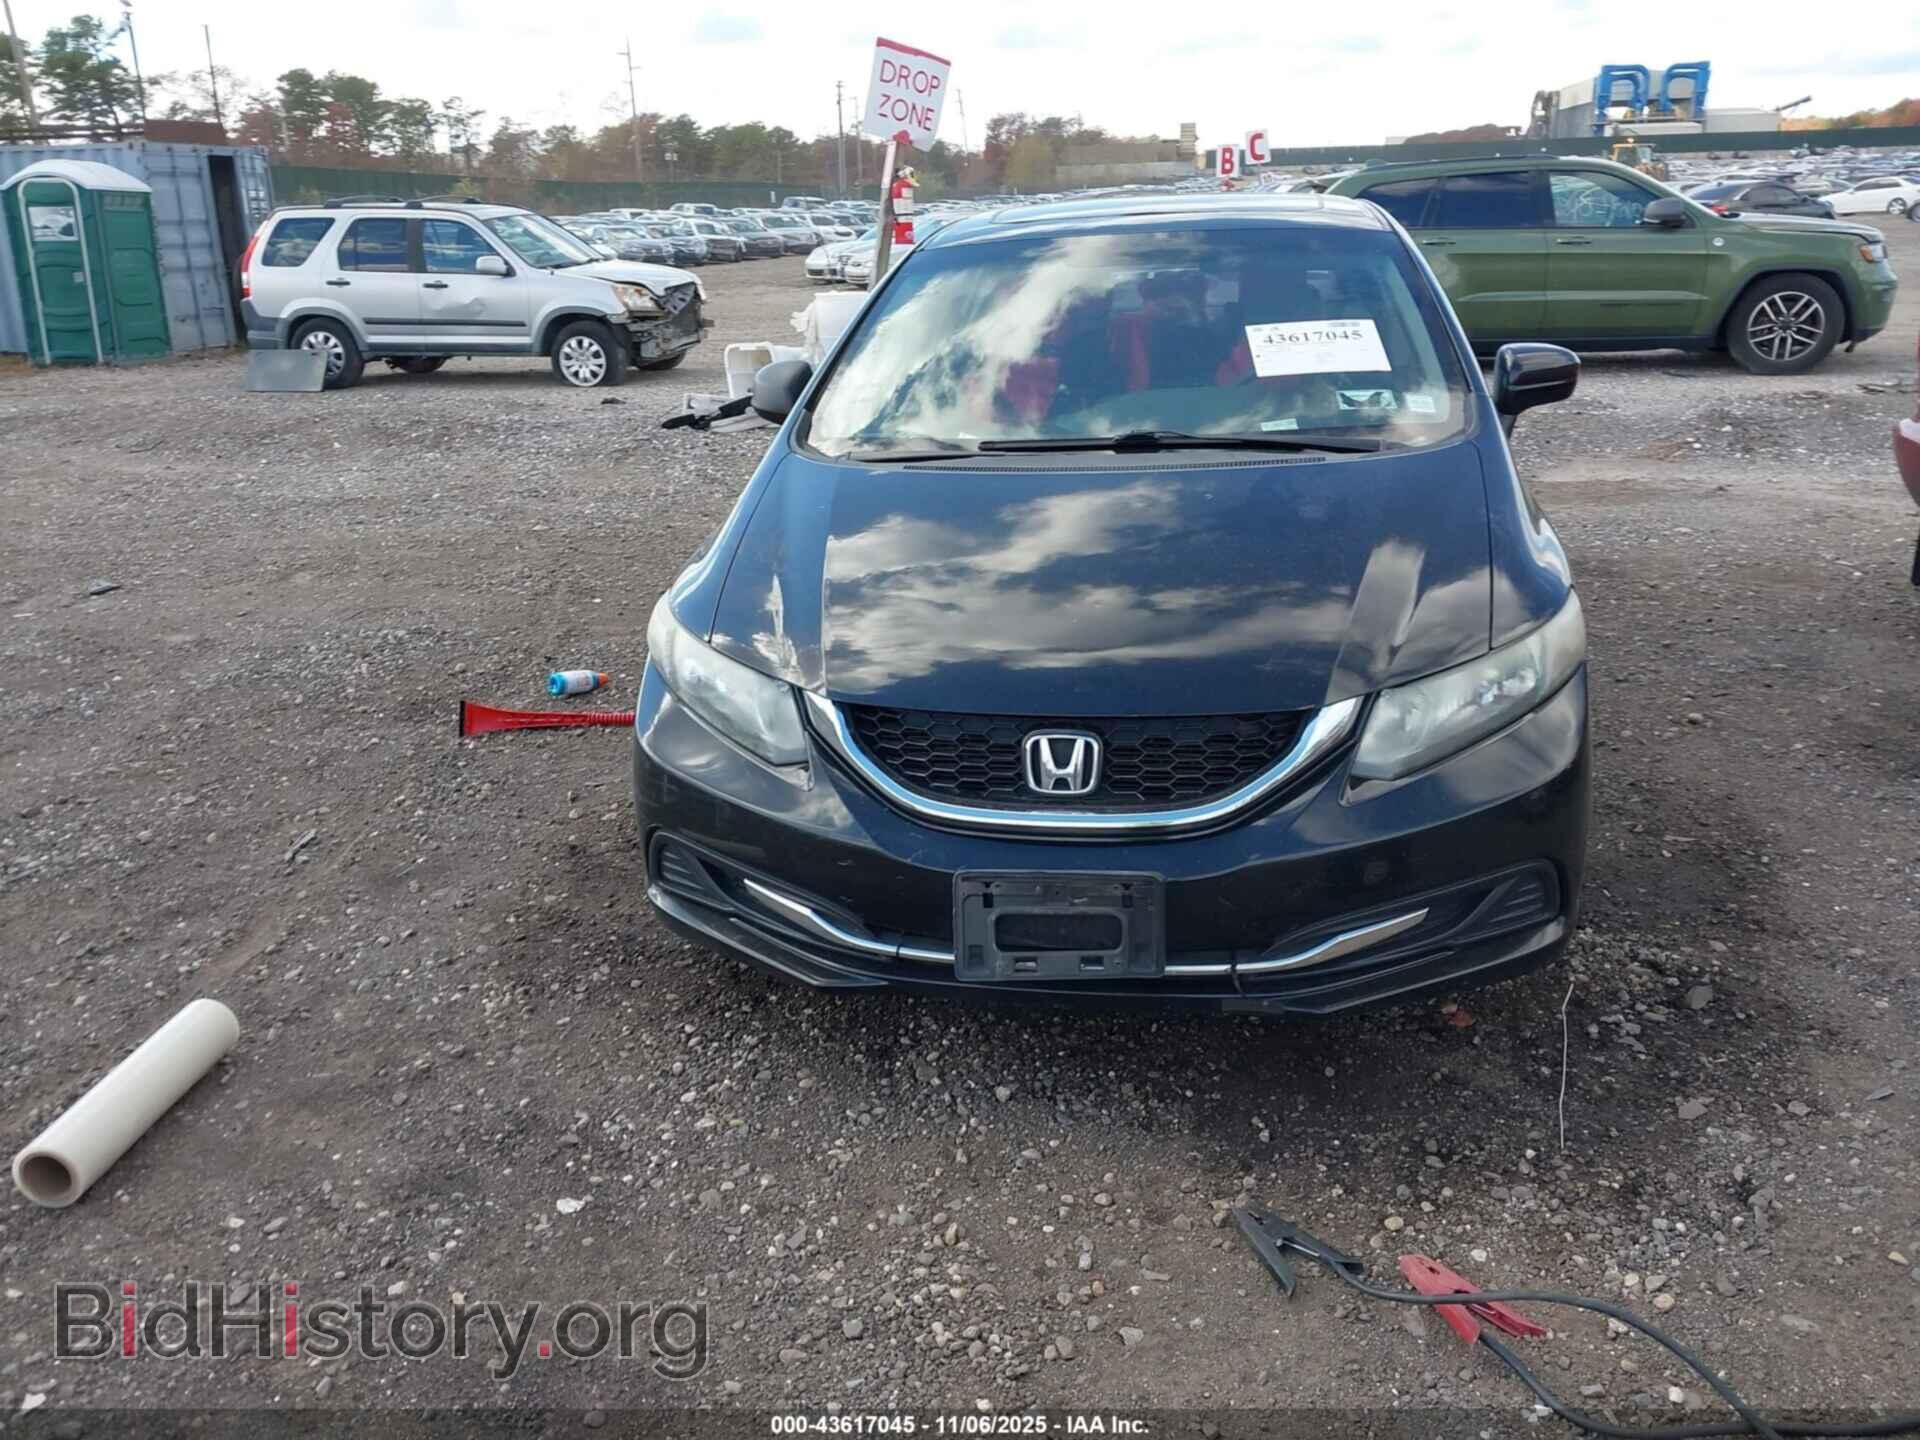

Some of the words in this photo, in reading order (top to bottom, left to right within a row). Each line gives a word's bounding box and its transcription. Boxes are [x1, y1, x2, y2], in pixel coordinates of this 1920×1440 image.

[880, 59, 941, 97] DROP
[878, 93, 936, 132] ZONE
[1221, 147, 1234, 175] B
[1250, 132, 1266, 162] C
[1263, 329, 1364, 346] 43617045
